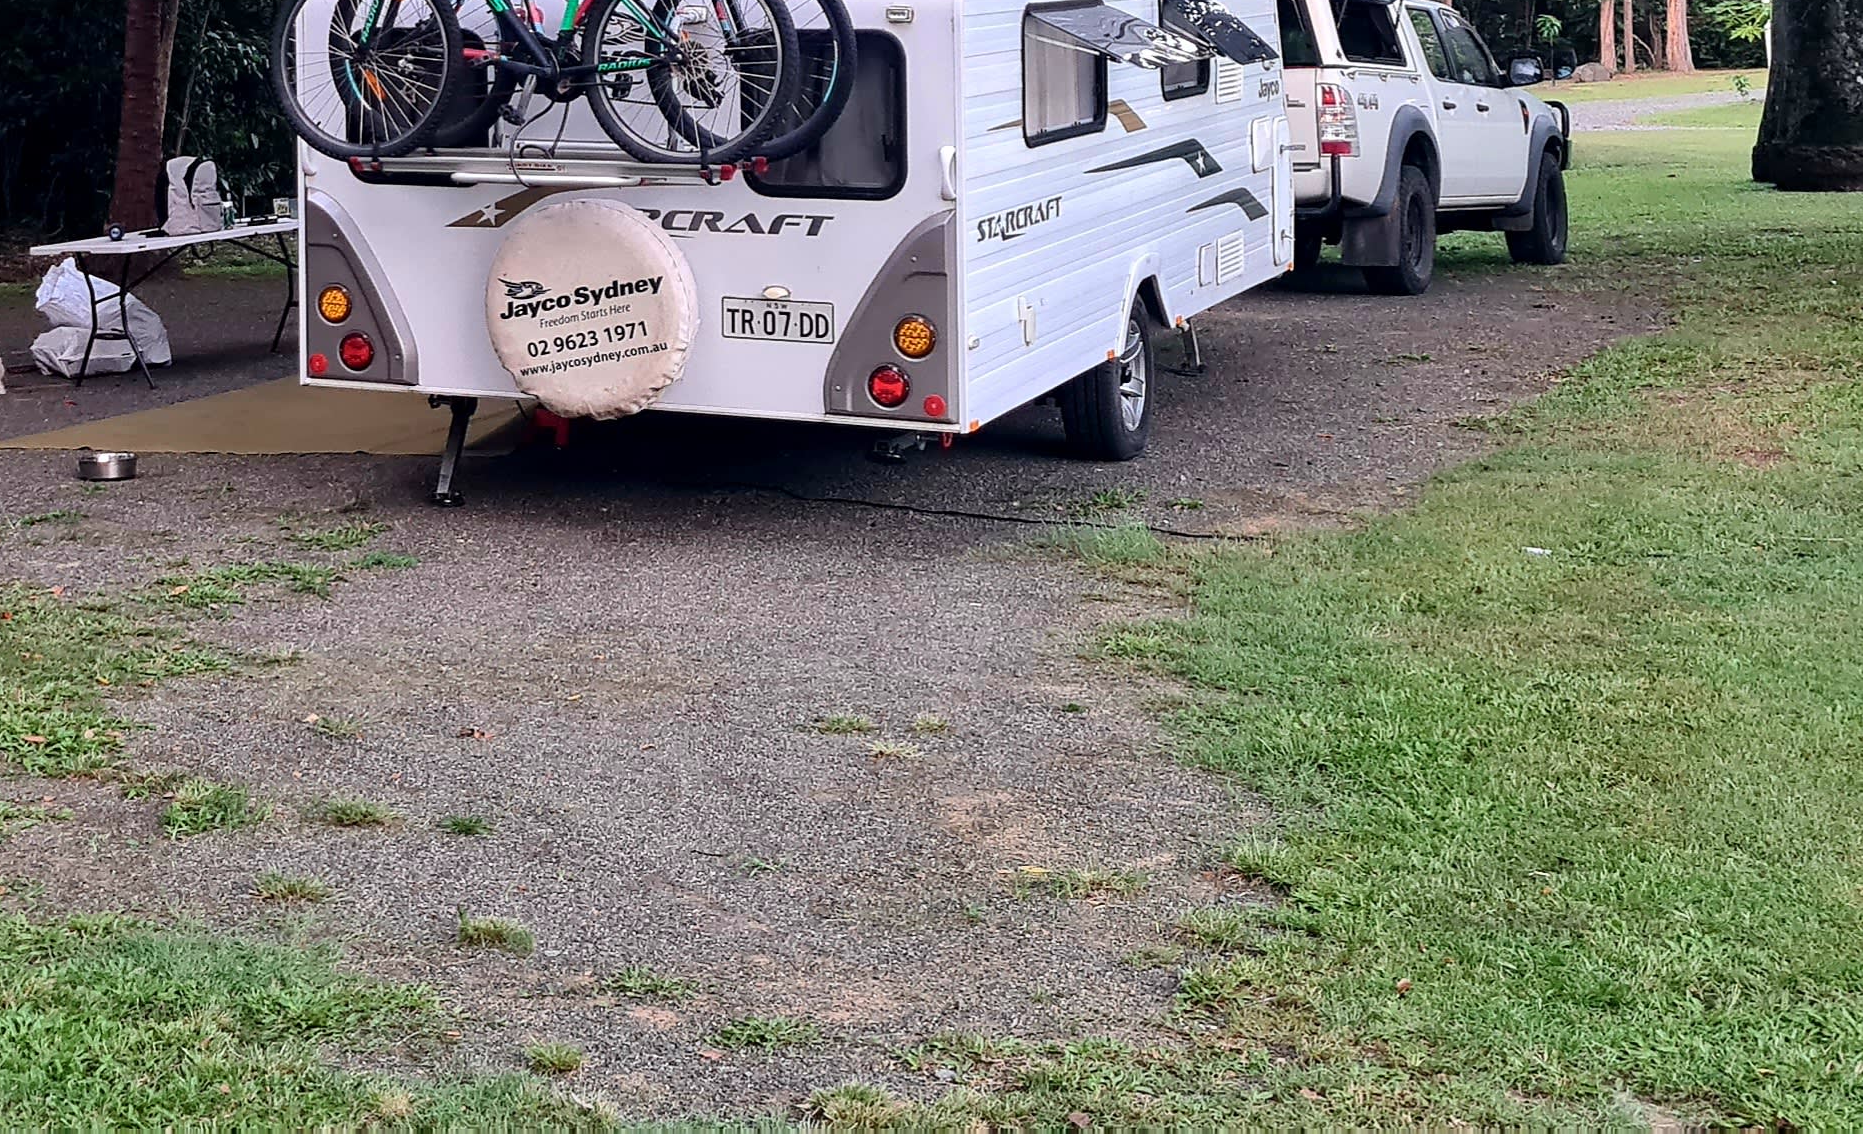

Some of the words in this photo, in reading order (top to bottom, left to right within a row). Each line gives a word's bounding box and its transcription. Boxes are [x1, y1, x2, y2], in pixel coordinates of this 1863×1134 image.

[1258, 78, 1280, 103] Jayco
[635, 208, 835, 238] CRAFT
[976, 195, 1063, 243] STARCRAFT
[500, 294, 571, 320] Jayco
[574, 276, 664, 306] Sydney
[539, 313, 580, 329] Freedom
[581, 307, 608, 322] Starts
[609, 303, 631, 315] Here
[527, 340, 551, 358] 02
[553, 329, 599, 353] 9623
[603, 320, 648, 343] 1971
[520, 341, 669, 377] www.jaycosydney.com.au
